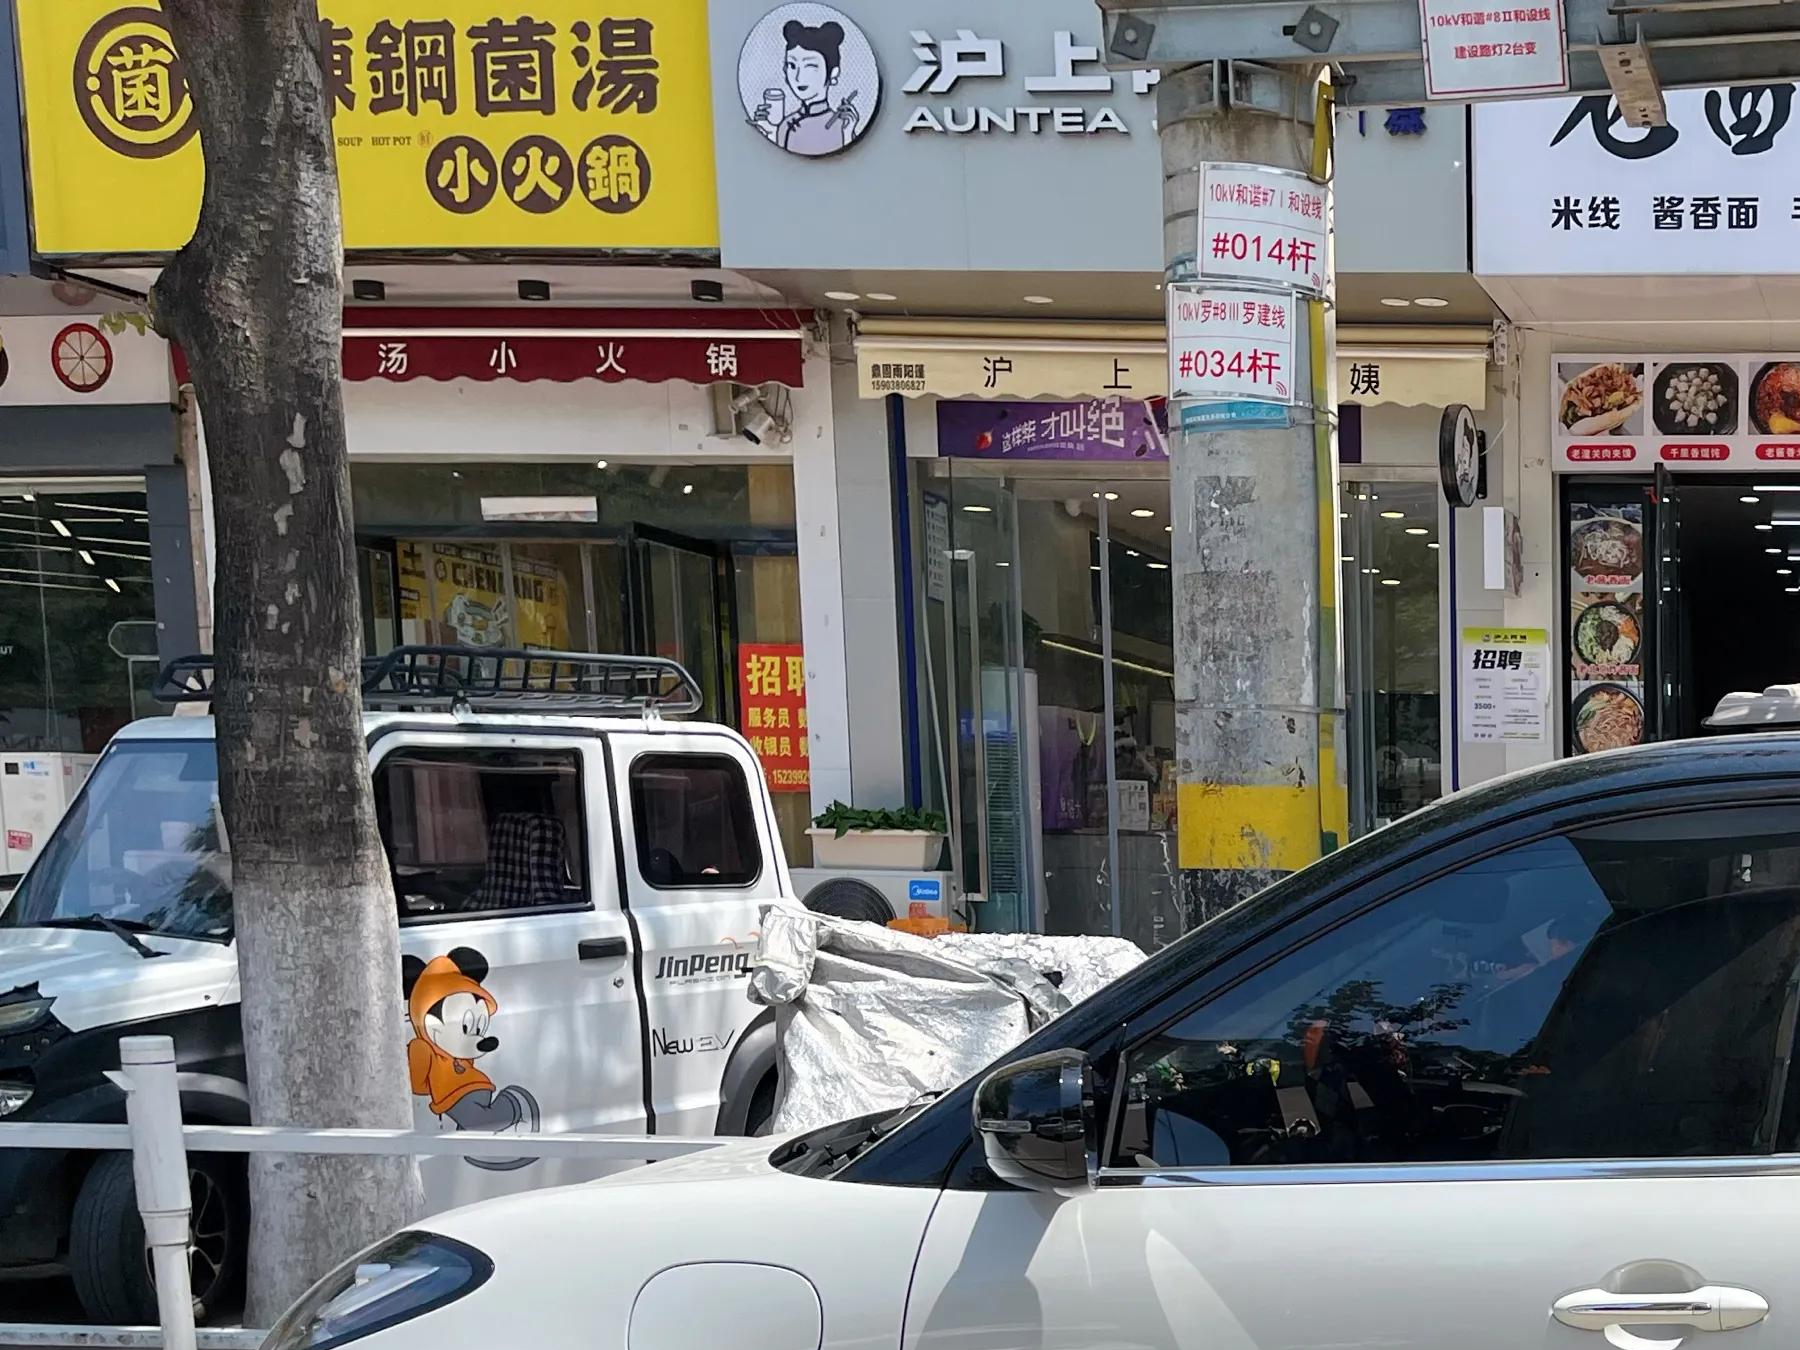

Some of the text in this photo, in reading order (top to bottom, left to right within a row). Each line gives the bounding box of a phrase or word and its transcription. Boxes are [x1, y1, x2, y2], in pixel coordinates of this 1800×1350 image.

[107, 43, 172, 122] 菌
[902, 106, 1130, 134] AUNTEA
[337, 137, 363, 147] SOUP
[371, 136, 391, 146] HOT
[392, 136, 412, 146] POT
[437, 145, 641, 203] 小火鍋
[1551, 196, 1621, 230] 米线
[1652, 195, 1760, 230] 酱香面
[1212, 232, 1317, 275] #014杆
[1179, 348, 1281, 385] #034杆
[1472, 649, 1522, 670] 招聘
[652, 1027, 694, 1057] New
